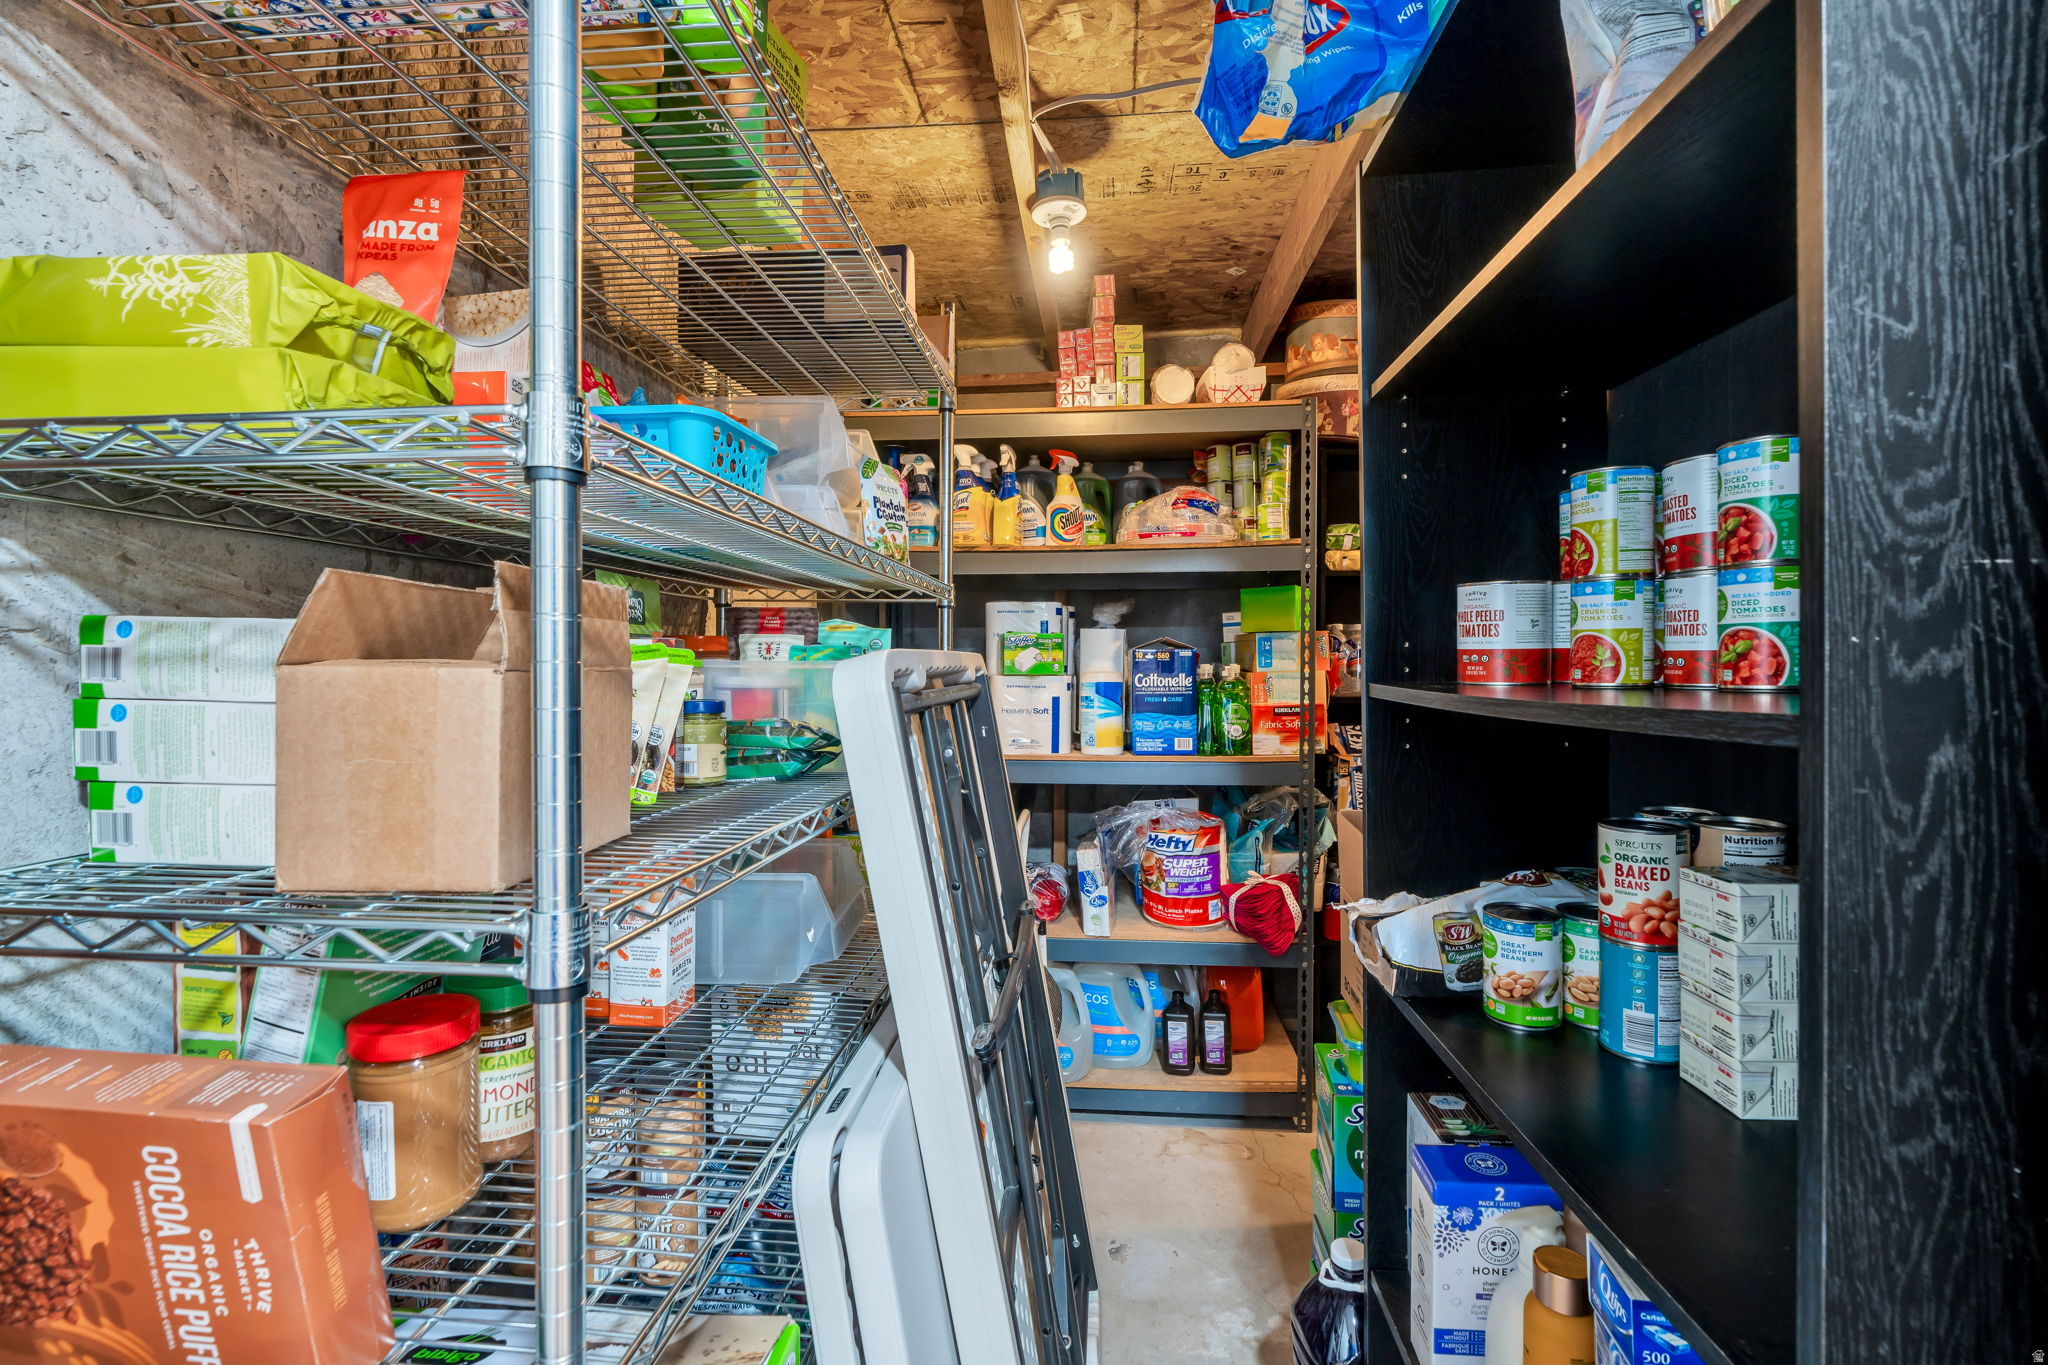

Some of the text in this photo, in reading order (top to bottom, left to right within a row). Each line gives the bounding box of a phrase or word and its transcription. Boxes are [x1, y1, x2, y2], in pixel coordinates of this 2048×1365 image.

[1397, 2, 1424, 24] Kills
[1321, 46, 1354, 59] Wipes
[400, 243, 436, 253] FROM
[1733, 467, 1749, 476] SALT
[1724, 475, 1749, 486] DICED
[1724, 479, 1774, 492] TOMATOES
[1059, 505, 1083, 531] SHOUT
[1731, 599, 1760, 607] DICED
[1457, 609, 1505, 623] WHOLE PEELED
[1731, 605, 1786, 615] TOMATOES
[1458, 623, 1500, 638] TOMATOES
[1004, 634, 1037, 646] Swiffer
[1135, 651, 1170, 659] 10 560
[1134, 673, 1193, 688] Cottonelle
[1001, 706, 1050, 717] Heavenly Soft
[1260, 720, 1284, 729] Fabric
[1148, 833, 1193, 852] Hefty
[1614, 838, 1662, 851] SPROUTS
[1723, 835, 1775, 846] Nutrition
[1163, 857, 1209, 869] SUPER
[1614, 852, 1670, 866] ORGANIC
[1170, 866, 1210, 877] WEIGHT
[1614, 863, 1671, 882] BAKED
[1614, 878, 1651, 892] BEANS
[670, 926, 694, 945] Pumpkin
[669, 942, 684, 957] Spice
[1443, 944, 1465, 952] BLACK
[1500, 940, 1527, 950] GREAT
[1500, 947, 1544, 957] NORTHERN
[1500, 953, 1527, 963] BEANS
[671, 957, 692, 977] BARISTA
[409, 978, 438, 998] INSIDE
[479, 1034, 526, 1050] KIRKLAND
[726, 1050, 771, 1075] oat
[140, 1144, 192, 1238] COCOA
[1494, 1186, 1505, 1202] 2
[1487, 1229, 1512, 1237] HONEST
[159, 1243, 206, 1305] RICE
[198, 1228, 230, 1318] ORGANIC
[243, 1237, 274, 1315] THRIVE
[708, 1302, 730, 1311] SPRING
[1640, 1312, 1666, 1322] Carton
[412, 1348, 481, 1364] bibigo
[1642, 1350, 1671, 1365] 500
